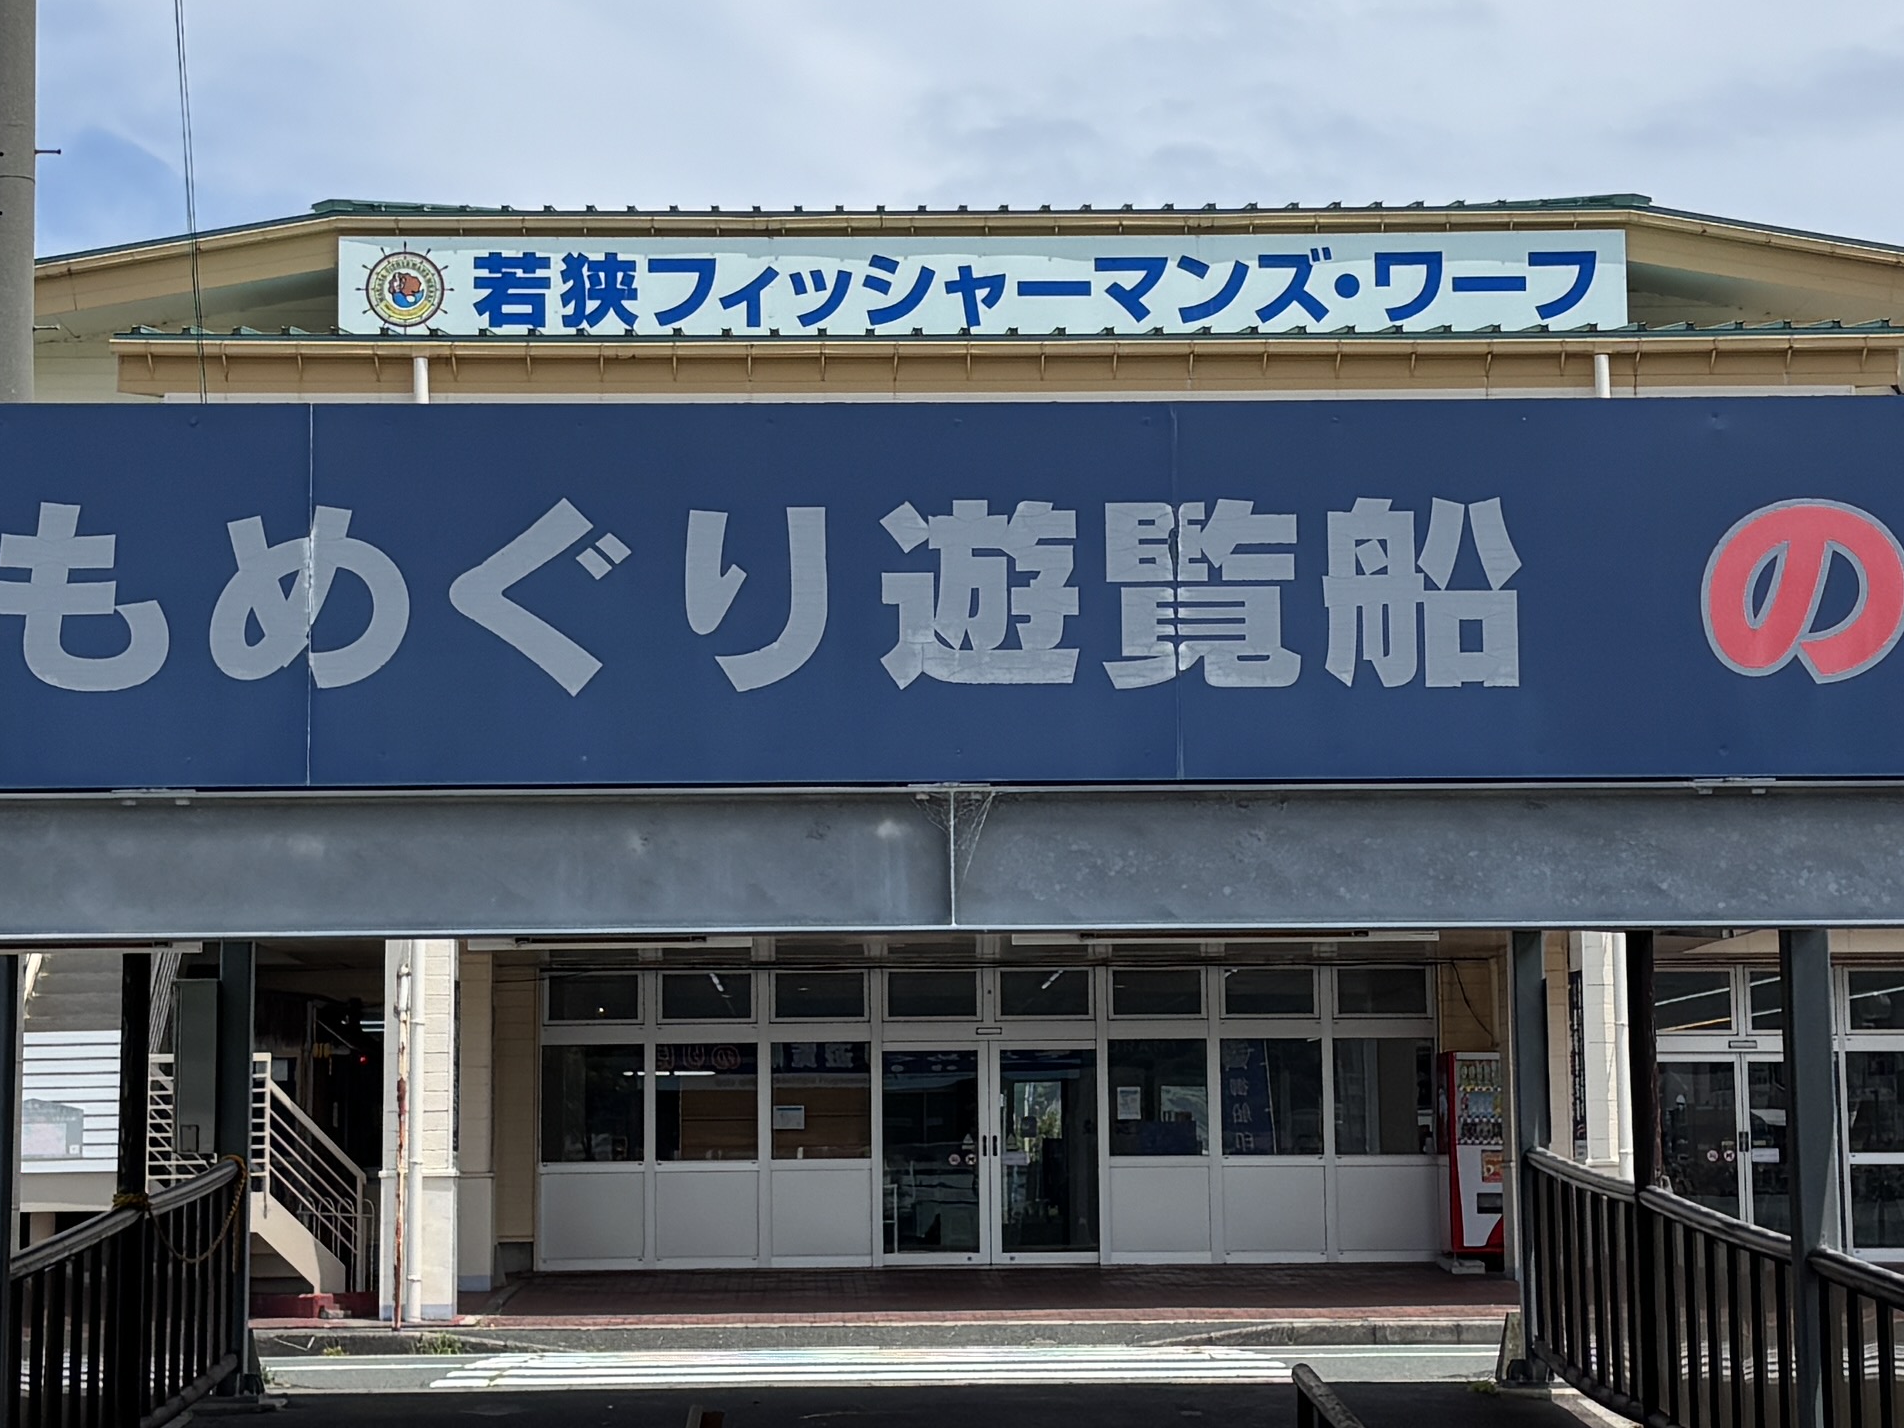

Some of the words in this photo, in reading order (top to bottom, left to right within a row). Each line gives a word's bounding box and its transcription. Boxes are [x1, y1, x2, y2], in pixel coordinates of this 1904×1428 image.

[472, 247, 1598, 329] 若狭フィッシャーマンズ・ワーフ
